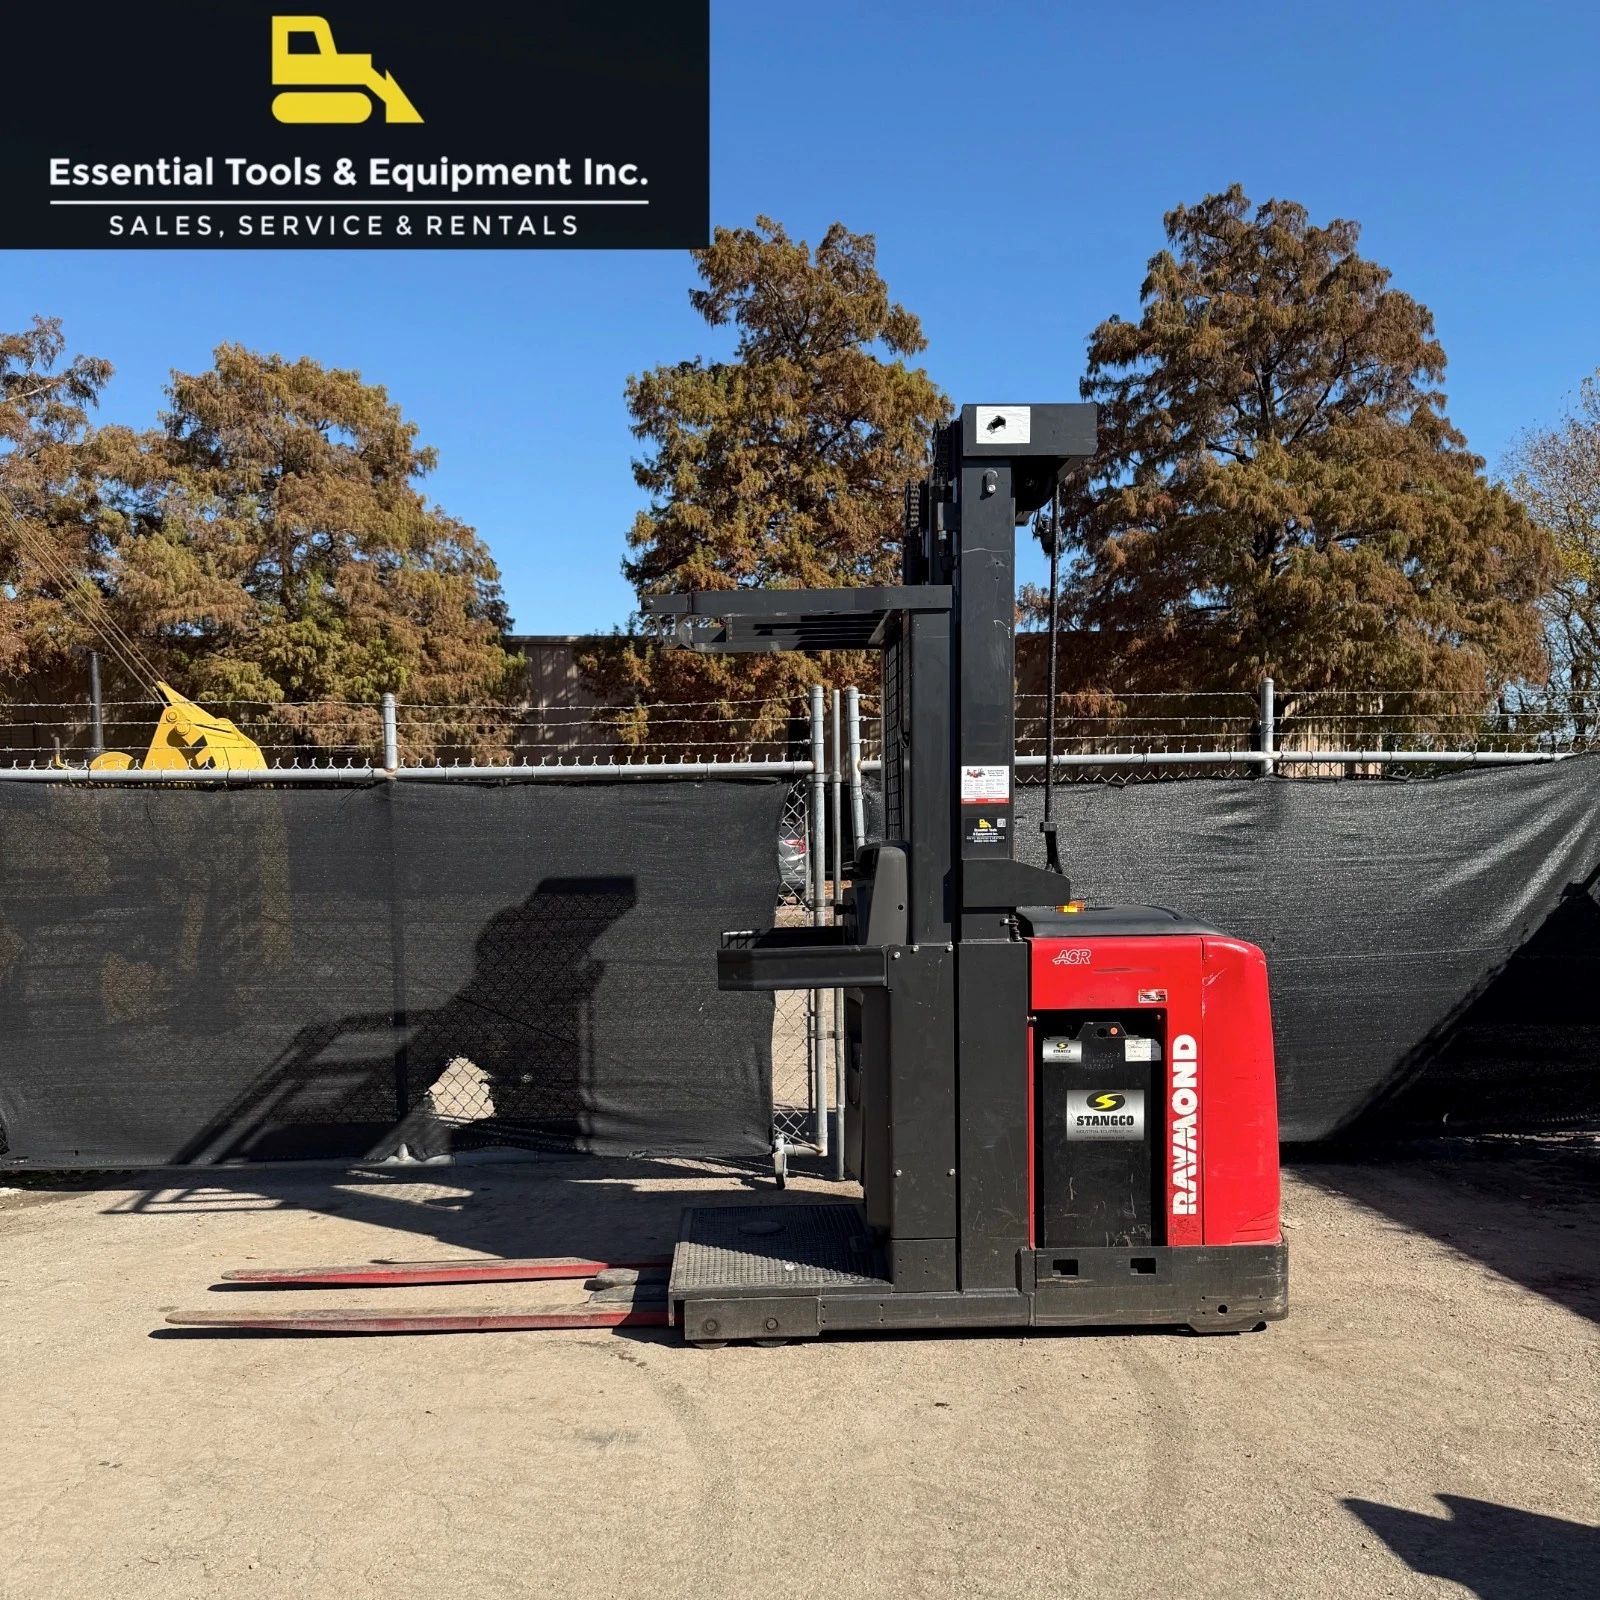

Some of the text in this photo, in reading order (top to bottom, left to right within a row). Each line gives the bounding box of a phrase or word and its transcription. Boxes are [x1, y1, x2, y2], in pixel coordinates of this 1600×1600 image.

[1052, 949, 1091, 965] ACR
[1076, 1115, 1135, 1126] STANGCO
[1172, 1034, 1198, 1215] RAYMOND
